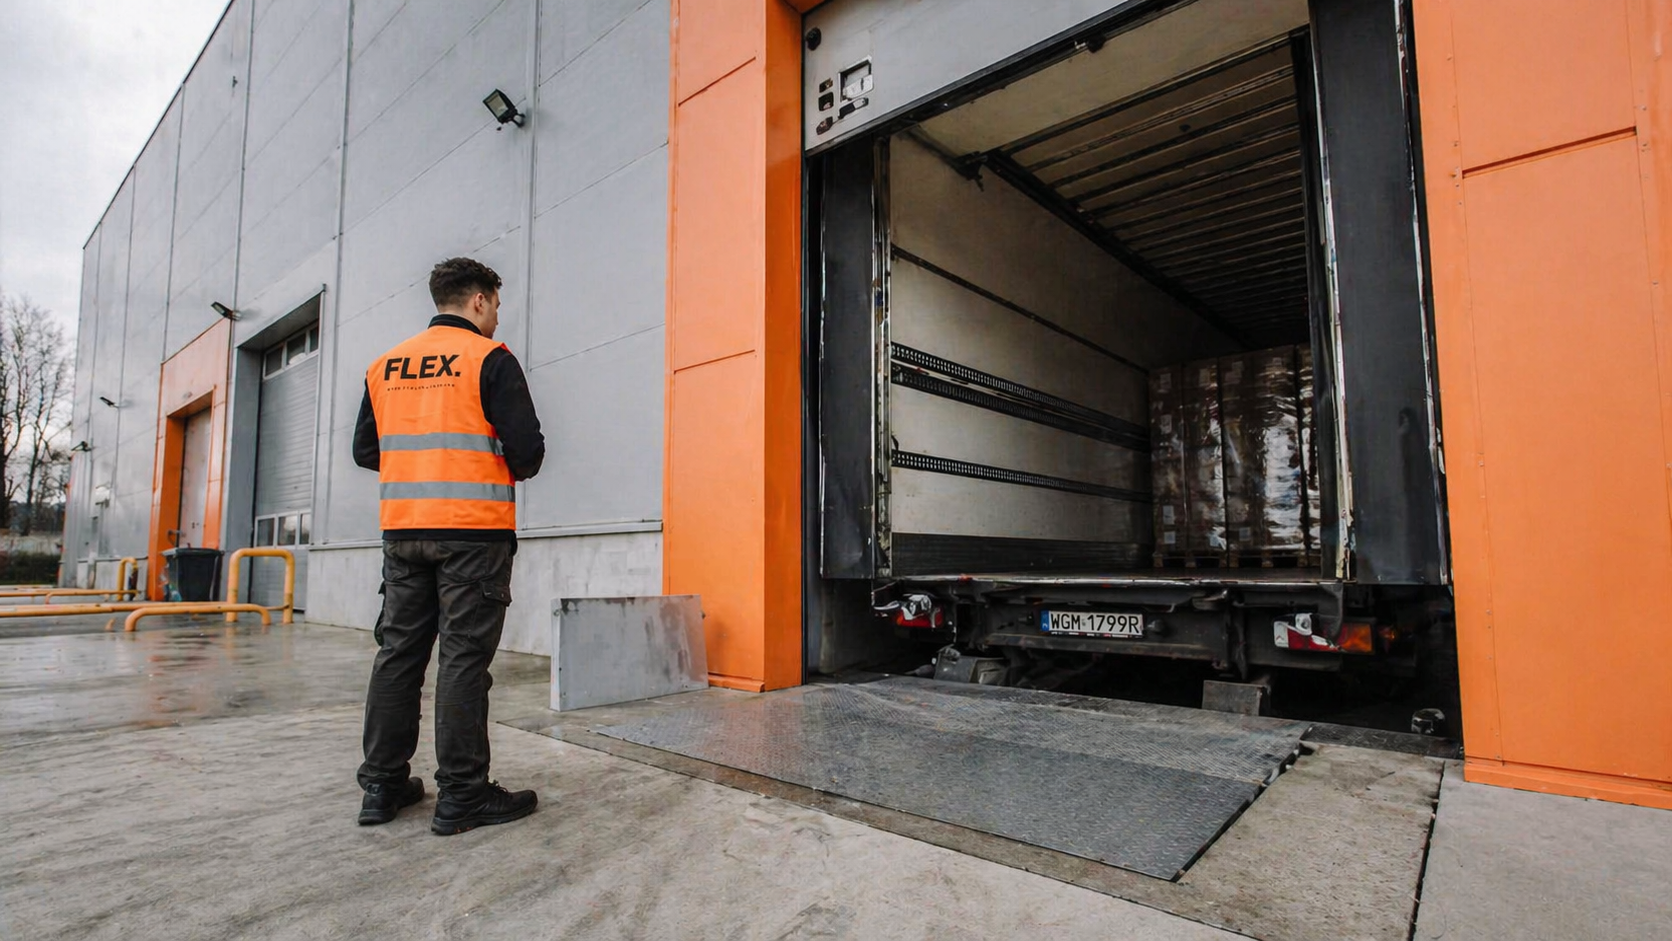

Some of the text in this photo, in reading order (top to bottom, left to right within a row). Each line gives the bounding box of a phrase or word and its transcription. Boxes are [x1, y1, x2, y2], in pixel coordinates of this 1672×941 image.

[384, 354, 461, 381] FLEX.
[1050, 613, 1140, 634] WGM 1799R
